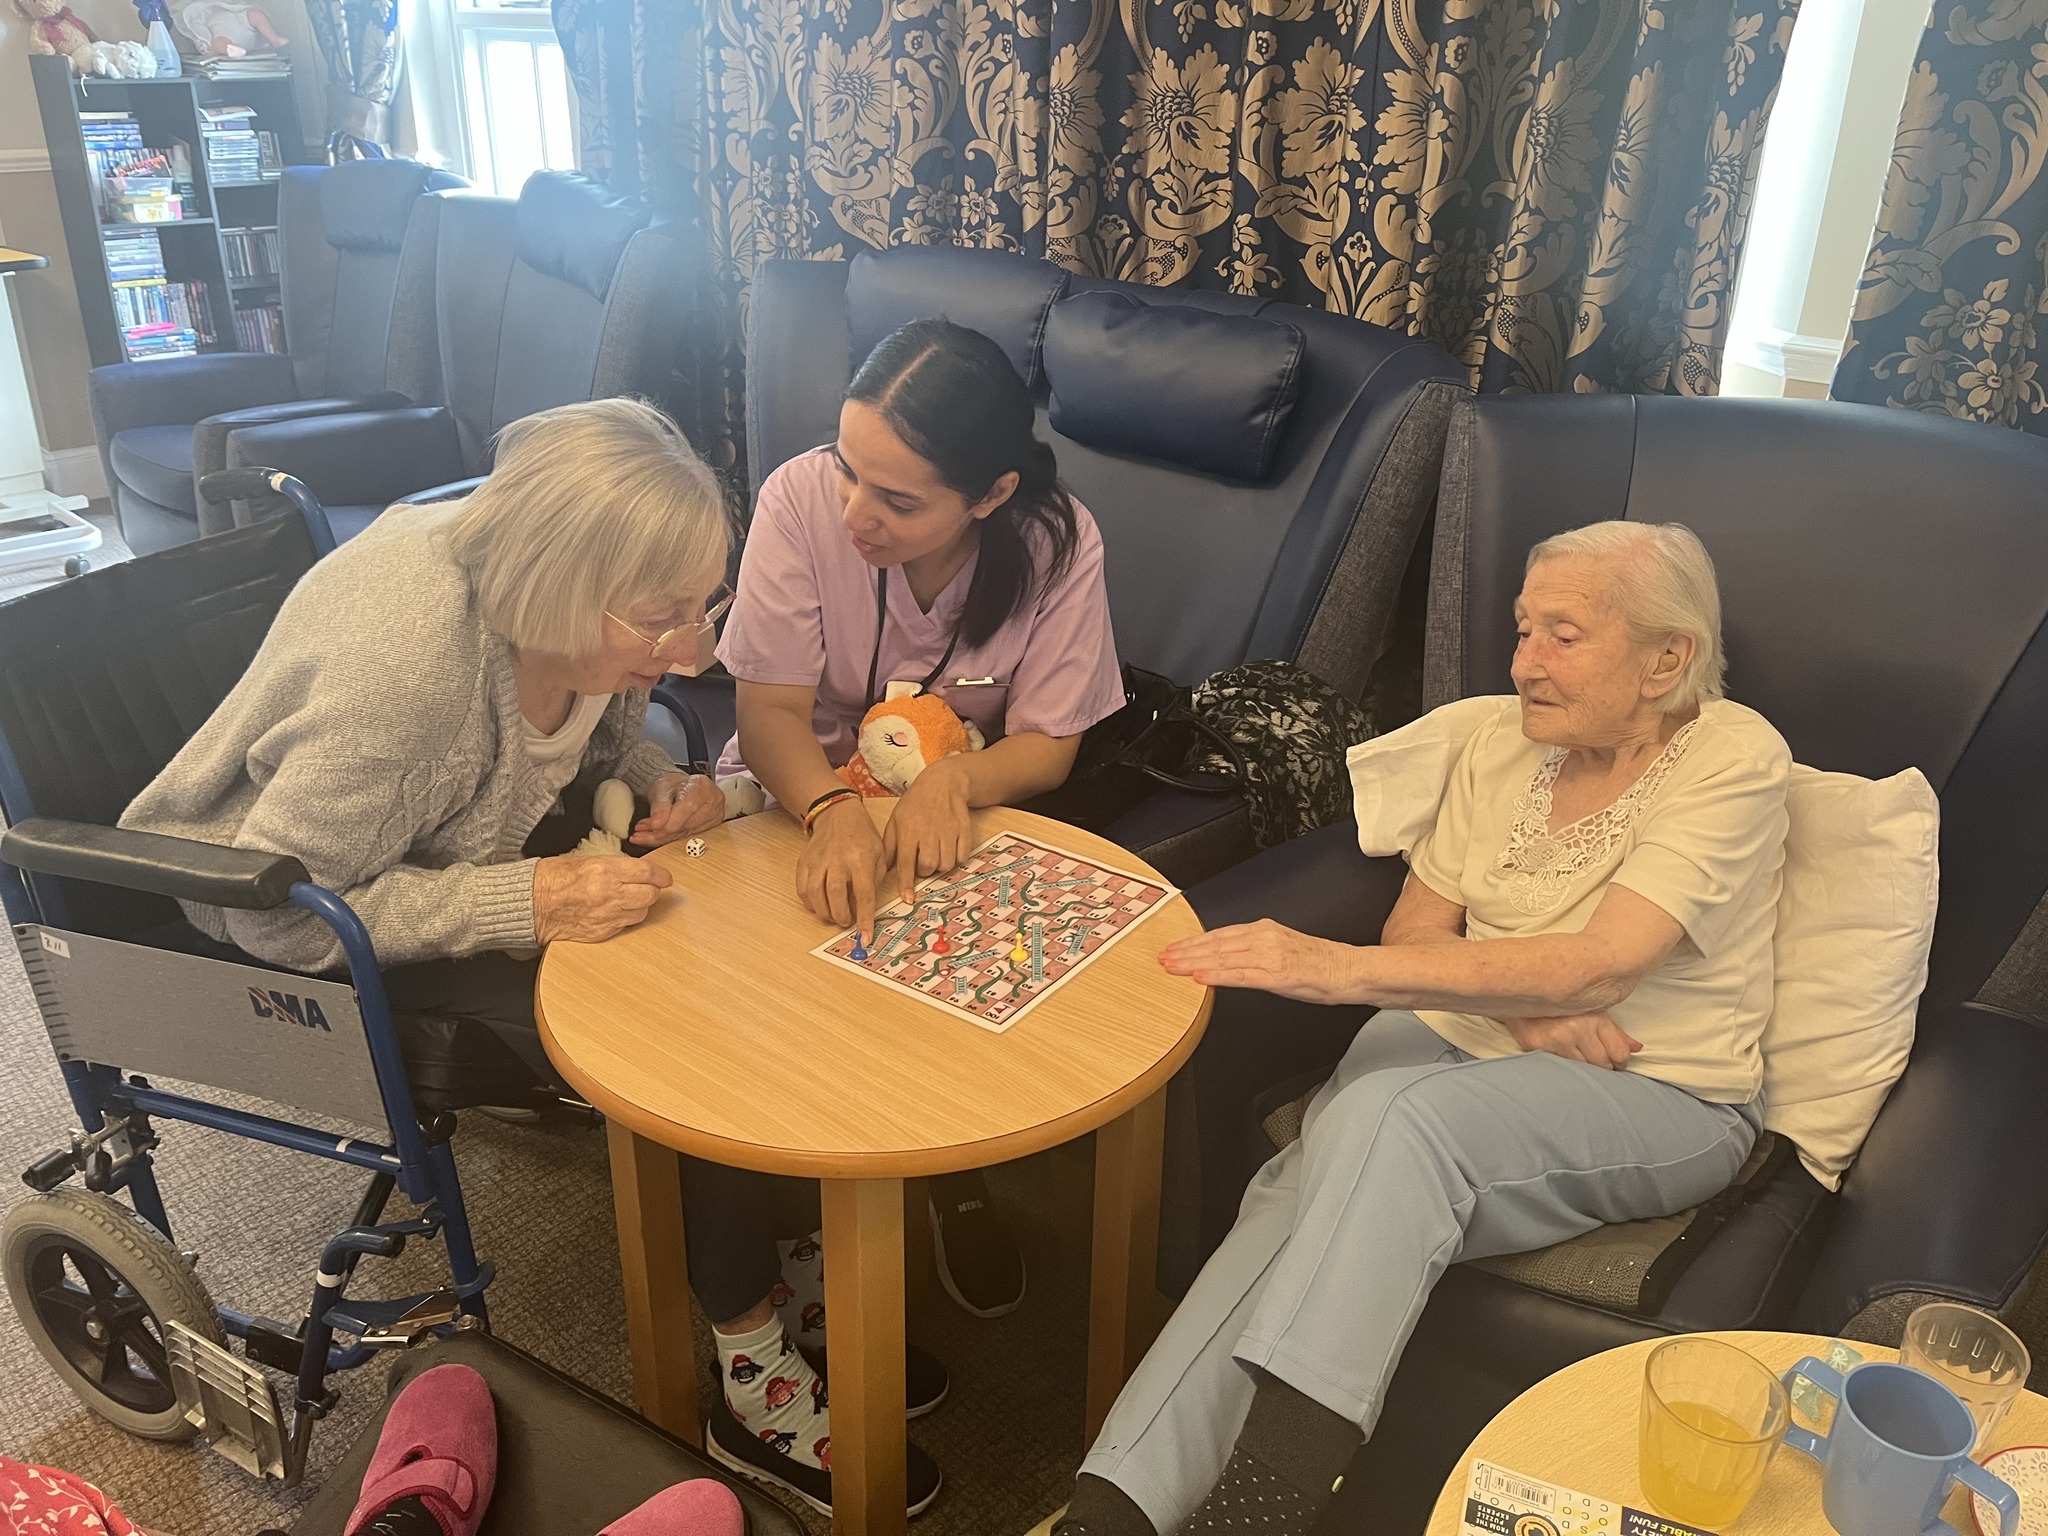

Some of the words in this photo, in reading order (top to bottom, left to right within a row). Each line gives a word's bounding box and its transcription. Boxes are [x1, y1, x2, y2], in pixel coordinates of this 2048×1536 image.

[246, 986, 332, 1033] DMA
[1476, 1512, 1504, 1526] PUZZLE
[1477, 1504, 1510, 1520] EXPERTS
[1475, 1517, 1489, 1527] THE
[1489, 1522, 1509, 1534] FROM
[1628, 1514, 1659, 1530] FUN!
